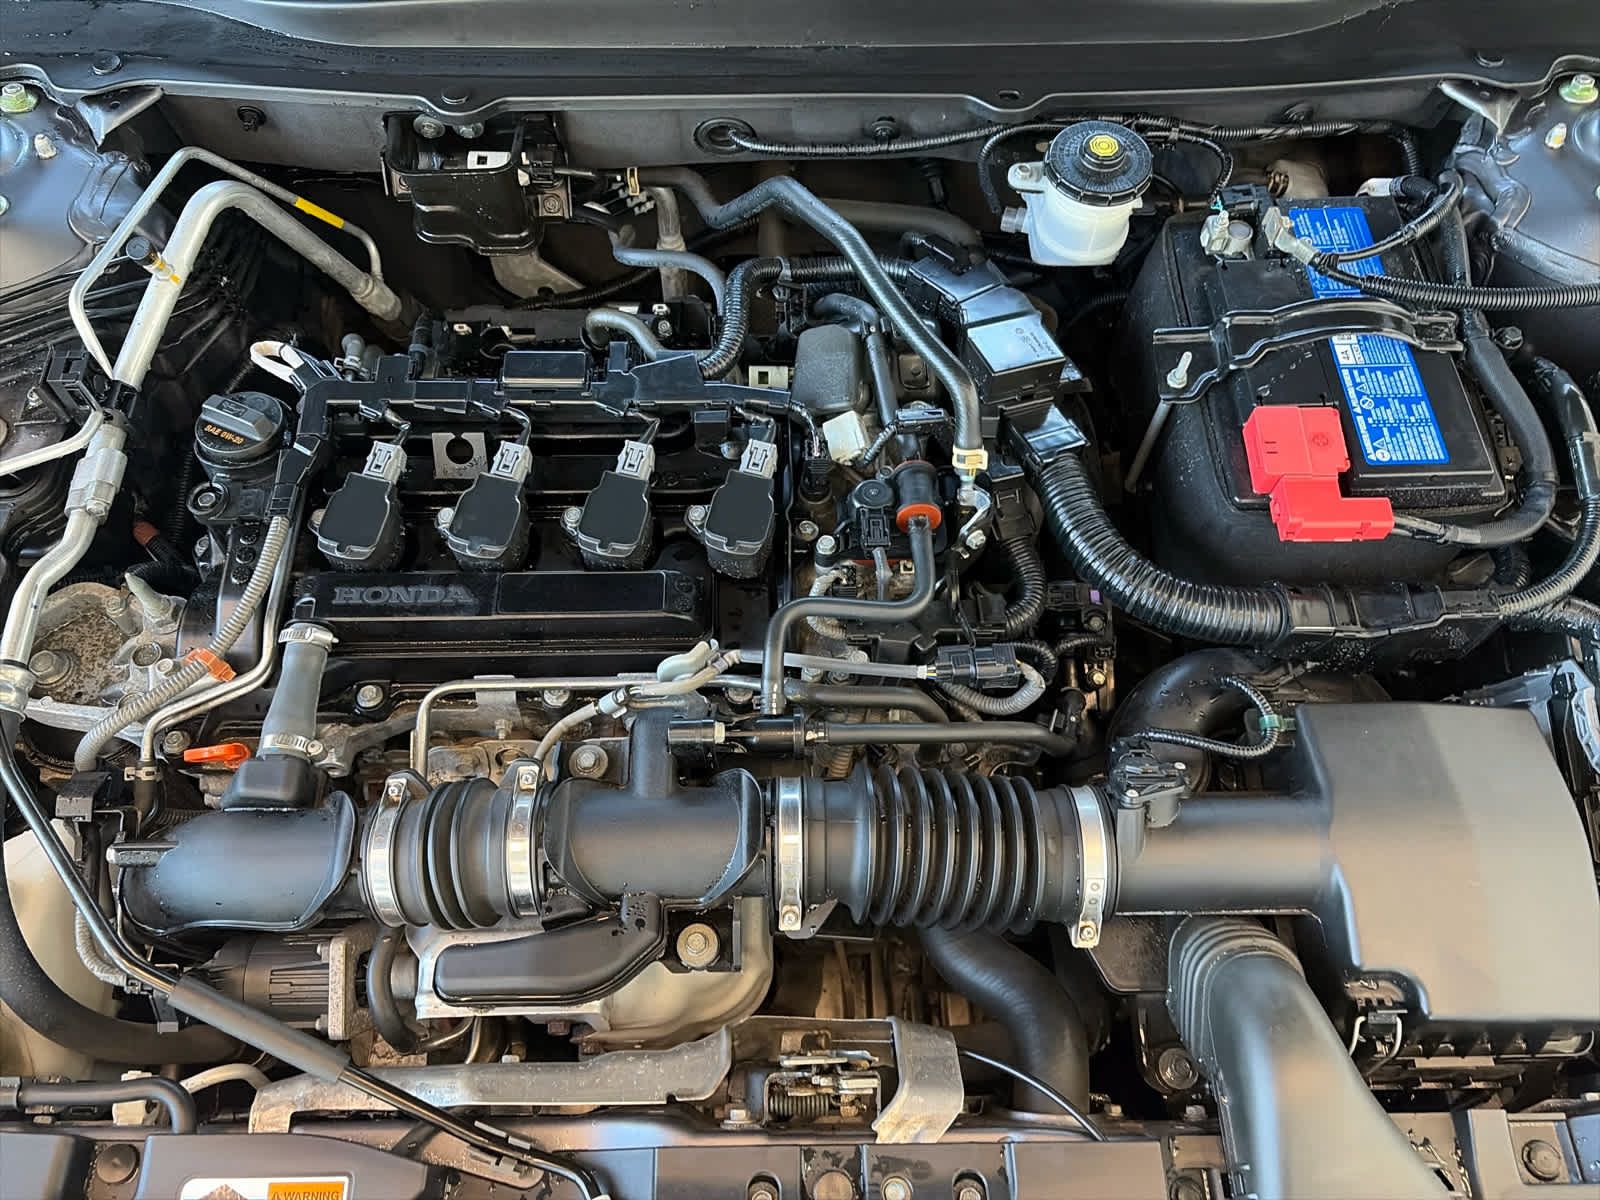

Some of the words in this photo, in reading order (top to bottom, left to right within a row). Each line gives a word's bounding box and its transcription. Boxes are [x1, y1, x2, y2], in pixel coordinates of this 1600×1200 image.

[204, 424, 222, 435] SAE
[220, 431, 244, 444] 0W-20
[332, 584, 475, 604] HONDA
[284, 1191, 340, 1200] WARNING
